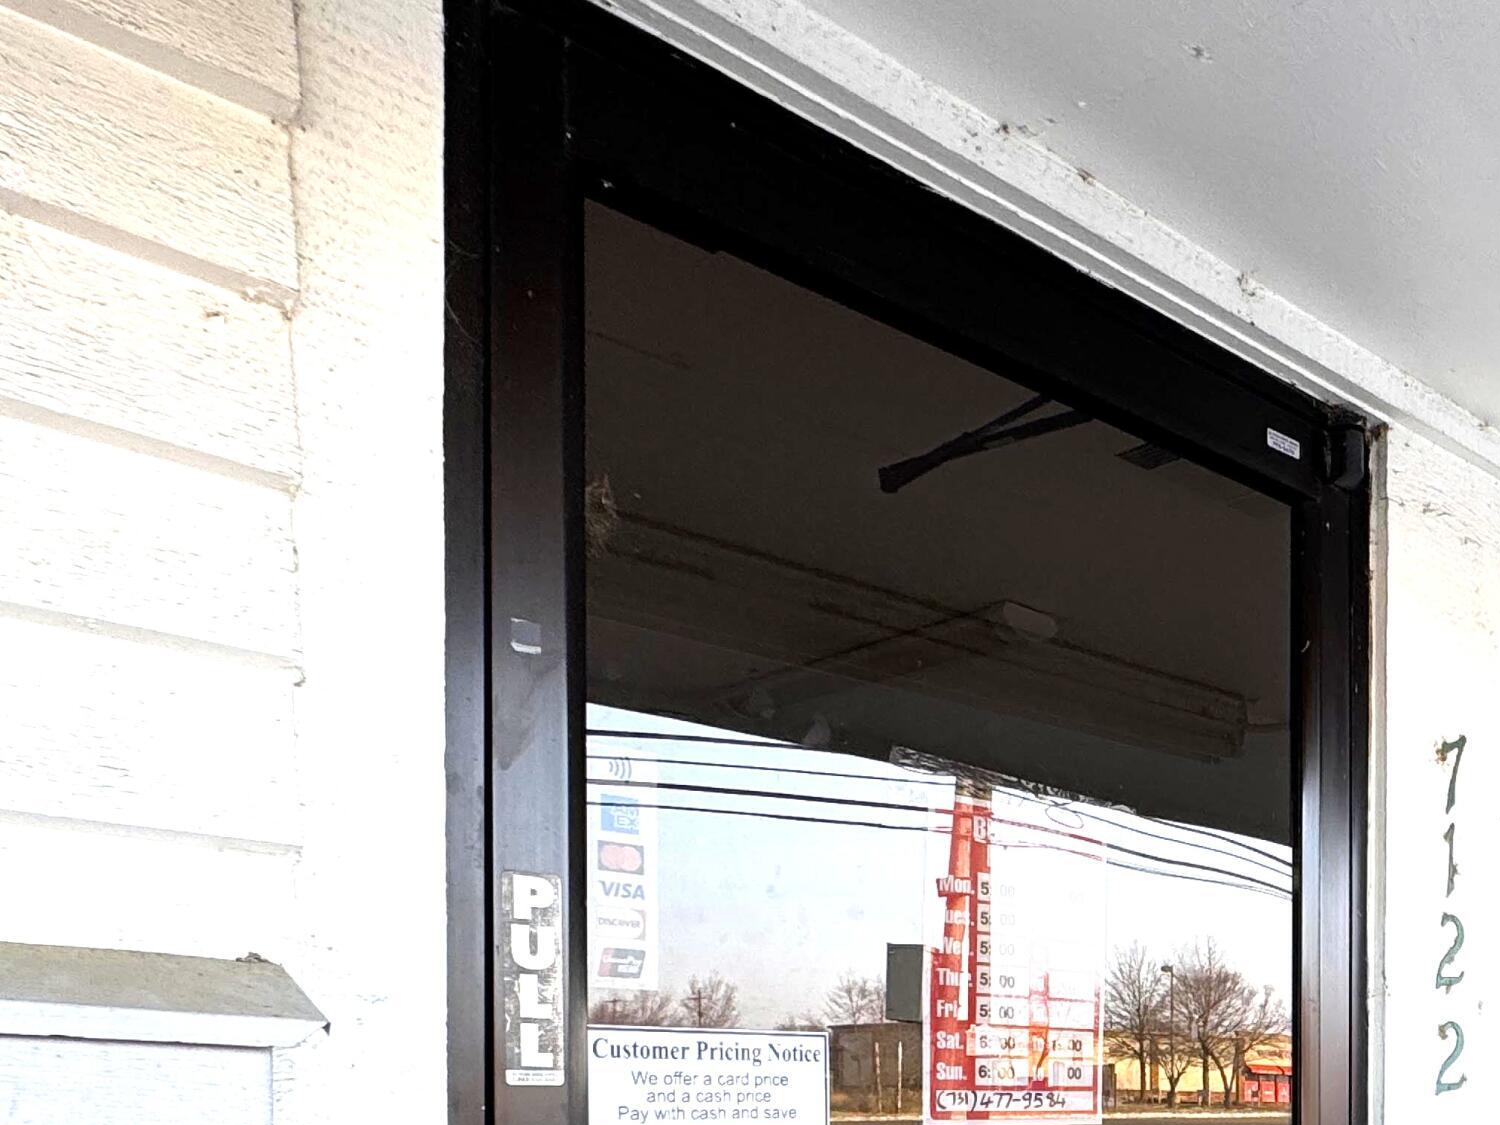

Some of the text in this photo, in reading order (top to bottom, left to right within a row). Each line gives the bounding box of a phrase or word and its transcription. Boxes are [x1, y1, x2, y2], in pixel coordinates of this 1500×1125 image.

[599, 880, 646, 901] VISA
[1436, 734, 1468, 1096] 7122
[510, 873, 556, 1069] PULL
[592, 1038, 821, 1066] Customer Pricing Notice
[631, 1071, 789, 1090] We offer a card price
[936, 1061, 968, 1081] Sun.
[646, 1090, 772, 1106] and a cash price
[936, 1090, 1066, 1112] (731)477-9584
[617, 1105, 797, 1124] Pay with cash and save
